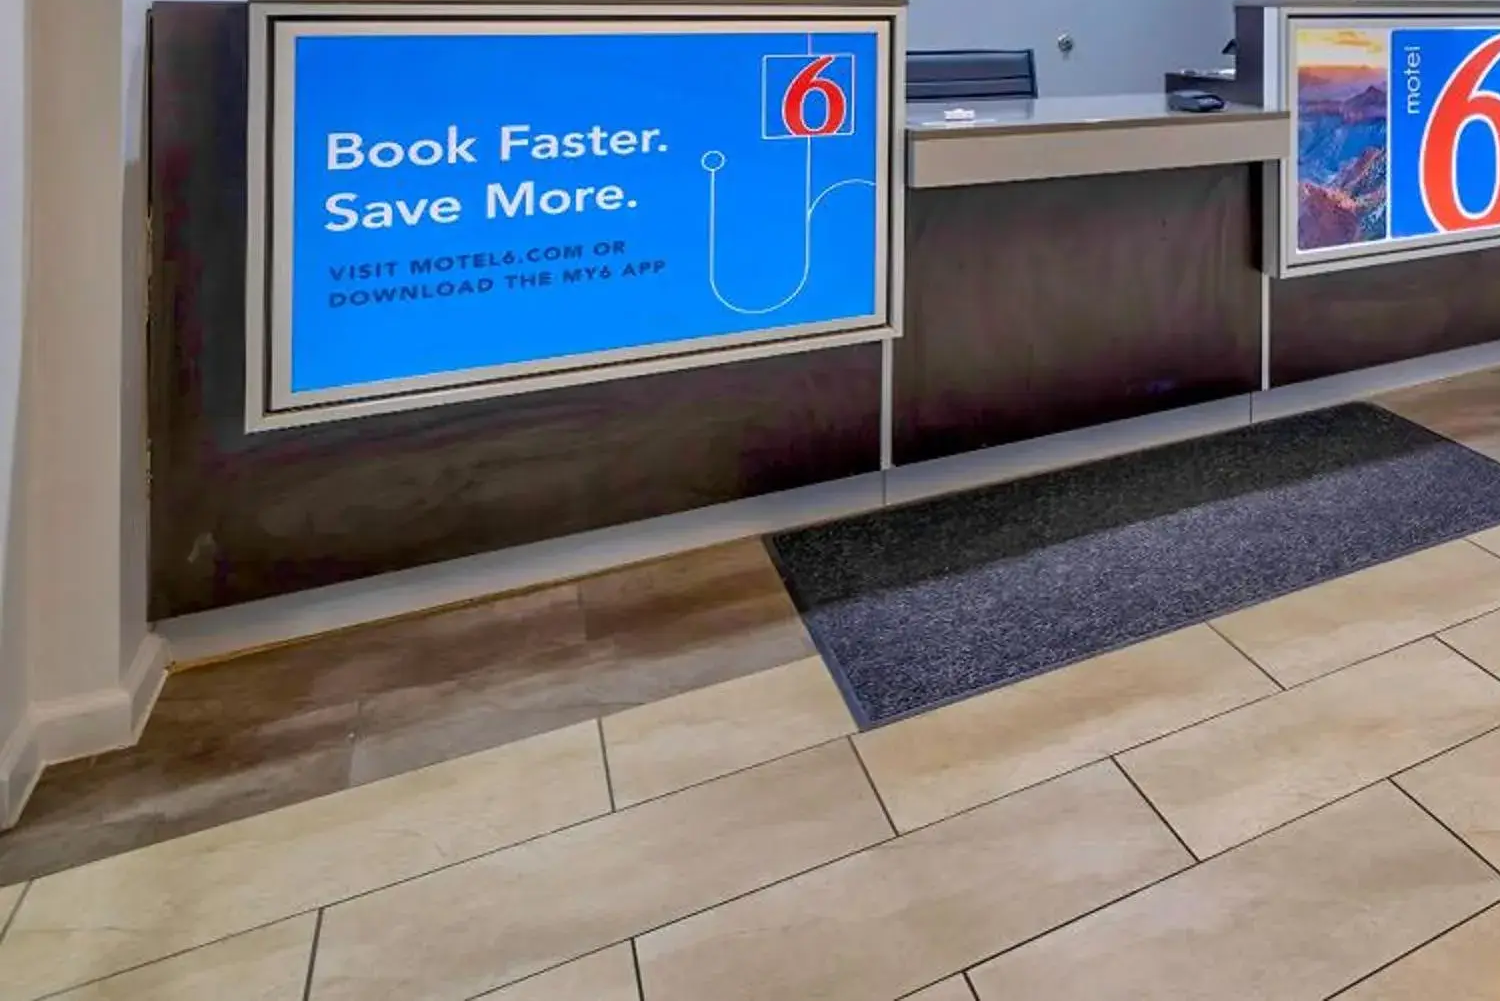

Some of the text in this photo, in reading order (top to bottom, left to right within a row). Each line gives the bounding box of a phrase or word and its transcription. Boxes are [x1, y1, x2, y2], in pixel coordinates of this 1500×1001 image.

[782, 54, 846, 136] 6
[1404, 46, 1421, 115] motel
[327, 124, 668, 170] Book Faster.
[324, 181, 637, 231] Save More.
[328, 260, 666, 308] DOWNLOAD THE MY6 APP
[329, 240, 626, 281] VISIT MOTEL6.COM OR
